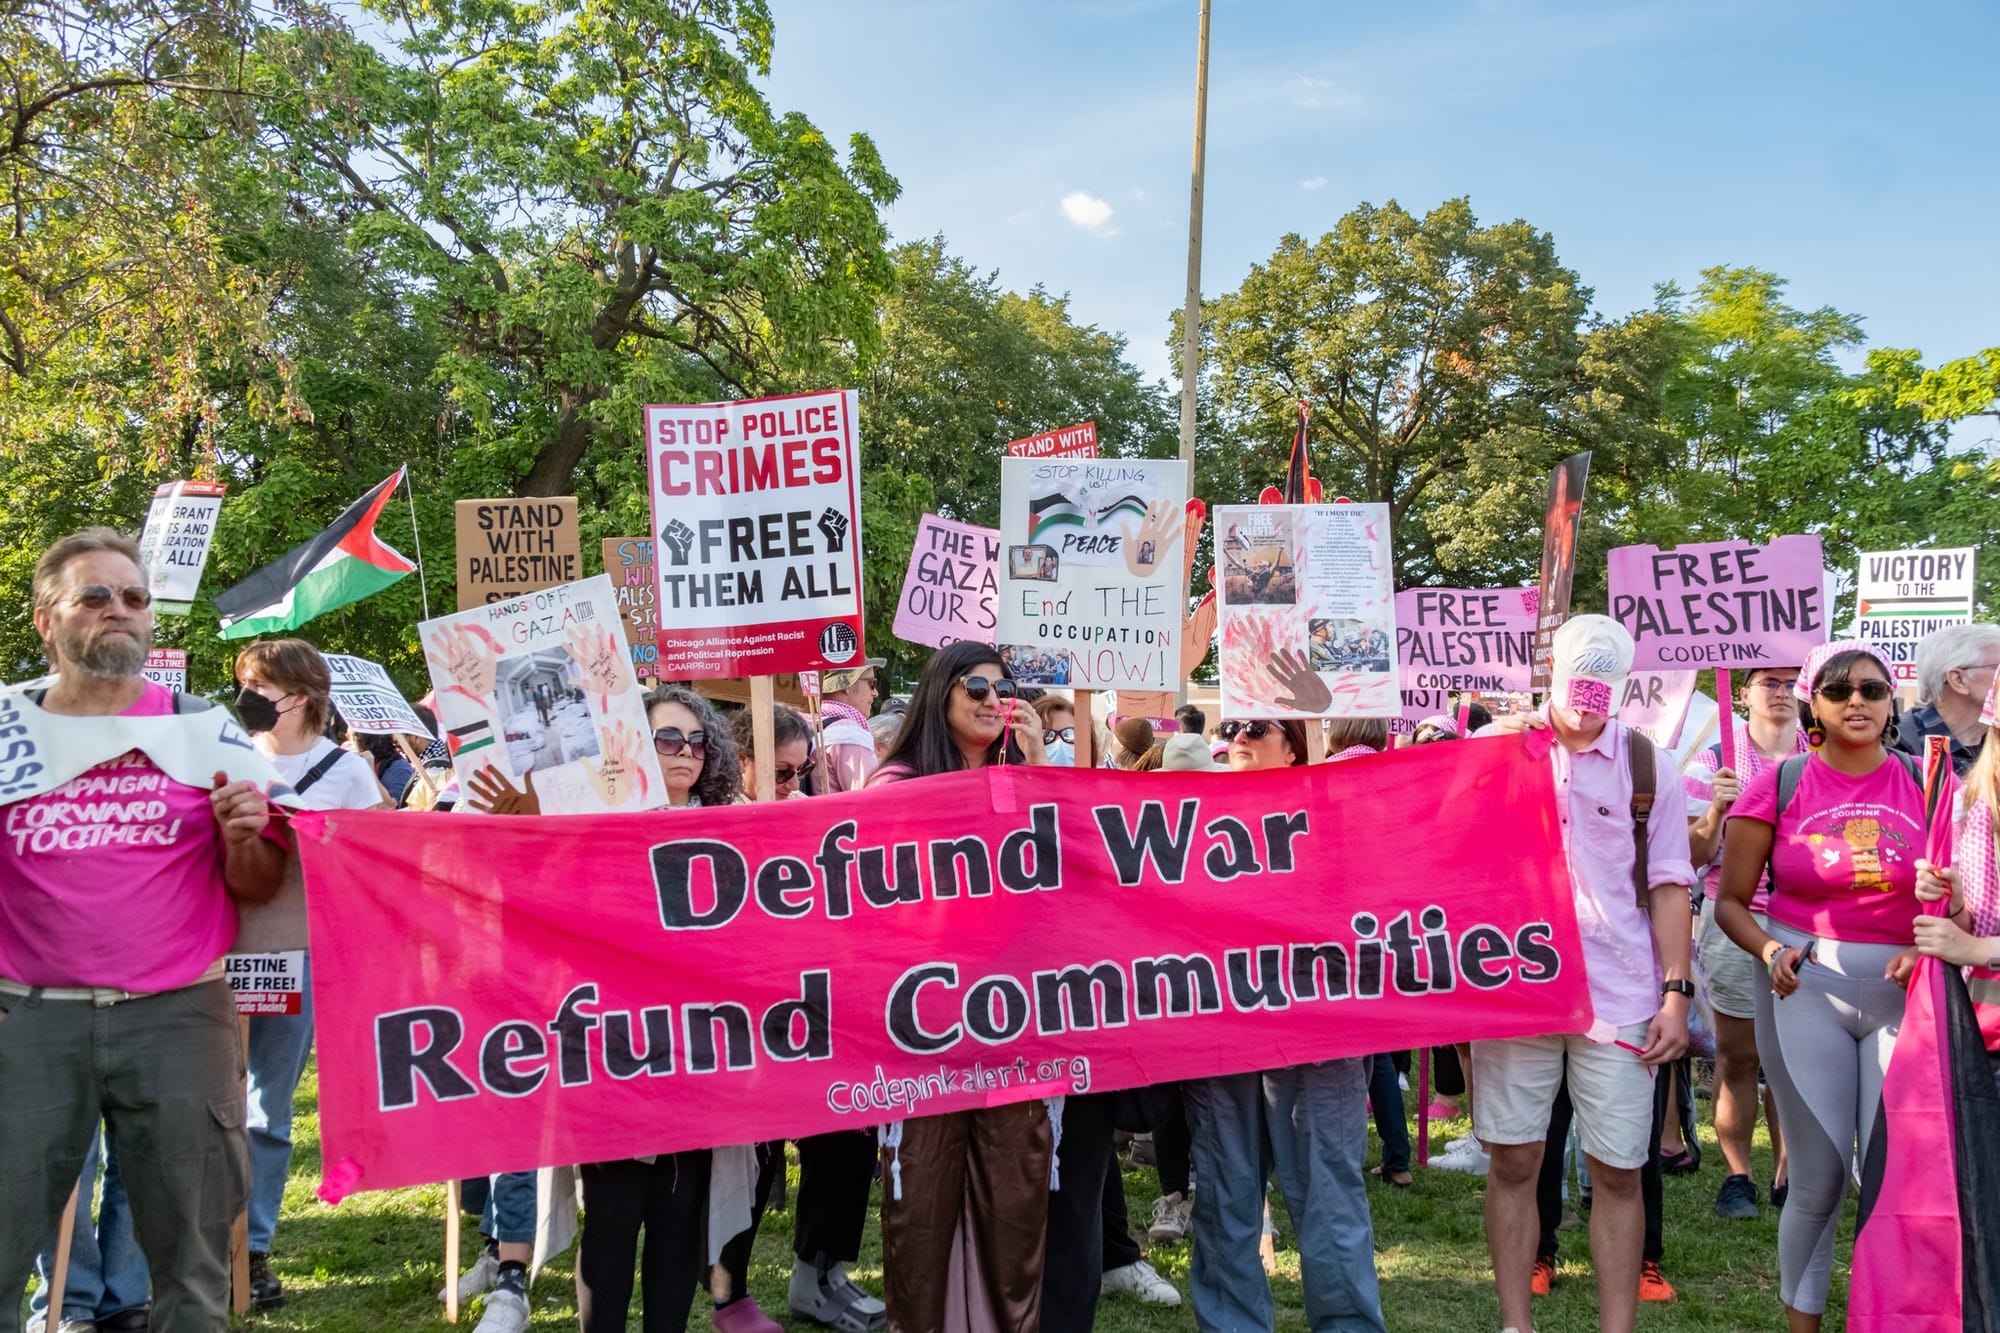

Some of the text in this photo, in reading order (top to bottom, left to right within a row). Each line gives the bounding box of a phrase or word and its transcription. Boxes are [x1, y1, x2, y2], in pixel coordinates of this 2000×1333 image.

[659, 405, 838, 445] STOP POLICE
[1012, 428, 1094, 459] STAND WITH
[660, 437, 842, 496] CRIMES
[1036, 465, 1145, 482] STOP KILLING
[183, 525, 209, 535] AND
[477, 504, 564, 530] STAND
[486, 531, 554, 554] WITH
[699, 511, 815, 564] FREE
[926, 525, 974, 558] THE
[1062, 534, 1122, 553] PEACE
[165, 550, 202, 566] ALL!
[470, 555, 575, 584] PALESTINE
[1652, 549, 1769, 590] FREE
[1870, 554, 1967, 582] VICTORY
[664, 562, 851, 608] THEM ALL
[917, 552, 998, 595] GAZA
[489, 601, 528, 621] HANDS
[535, 585, 571, 611] OFF
[1023, 585, 1165, 616] End THE
[1897, 583, 1934, 596] TO THE
[909, 586, 968, 623] OUR
[1417, 592, 1506, 627] FREE
[1614, 587, 1821, 641] PALESTINE
[667, 631, 805, 649] Chicago Alliance Against Racist
[1039, 624, 1170, 648] OCCUPATION
[668, 646, 774, 661] and Political Repression
[668, 661, 721, 672] CAARPR.org
[1658, 643, 1770, 662] CODEPINK
[1069, 649, 1164, 687] NOW!
[1417, 674, 1504, 691] CODEPINK
[1571, 680, 1584, 707] WAR
[1581, 680, 1595, 709] NOT
[1592, 683, 1604, 712] OUT
[6, 801, 167, 834] FORWARD
[1832, 809, 1880, 819] CODEPINK
[10, 819, 182, 856] TOGETHER!
[648, 798, 1309, 931] Defund War
[232, 977, 296, 991] BE FREE!
[375, 904, 1561, 1114] Refund Communities
